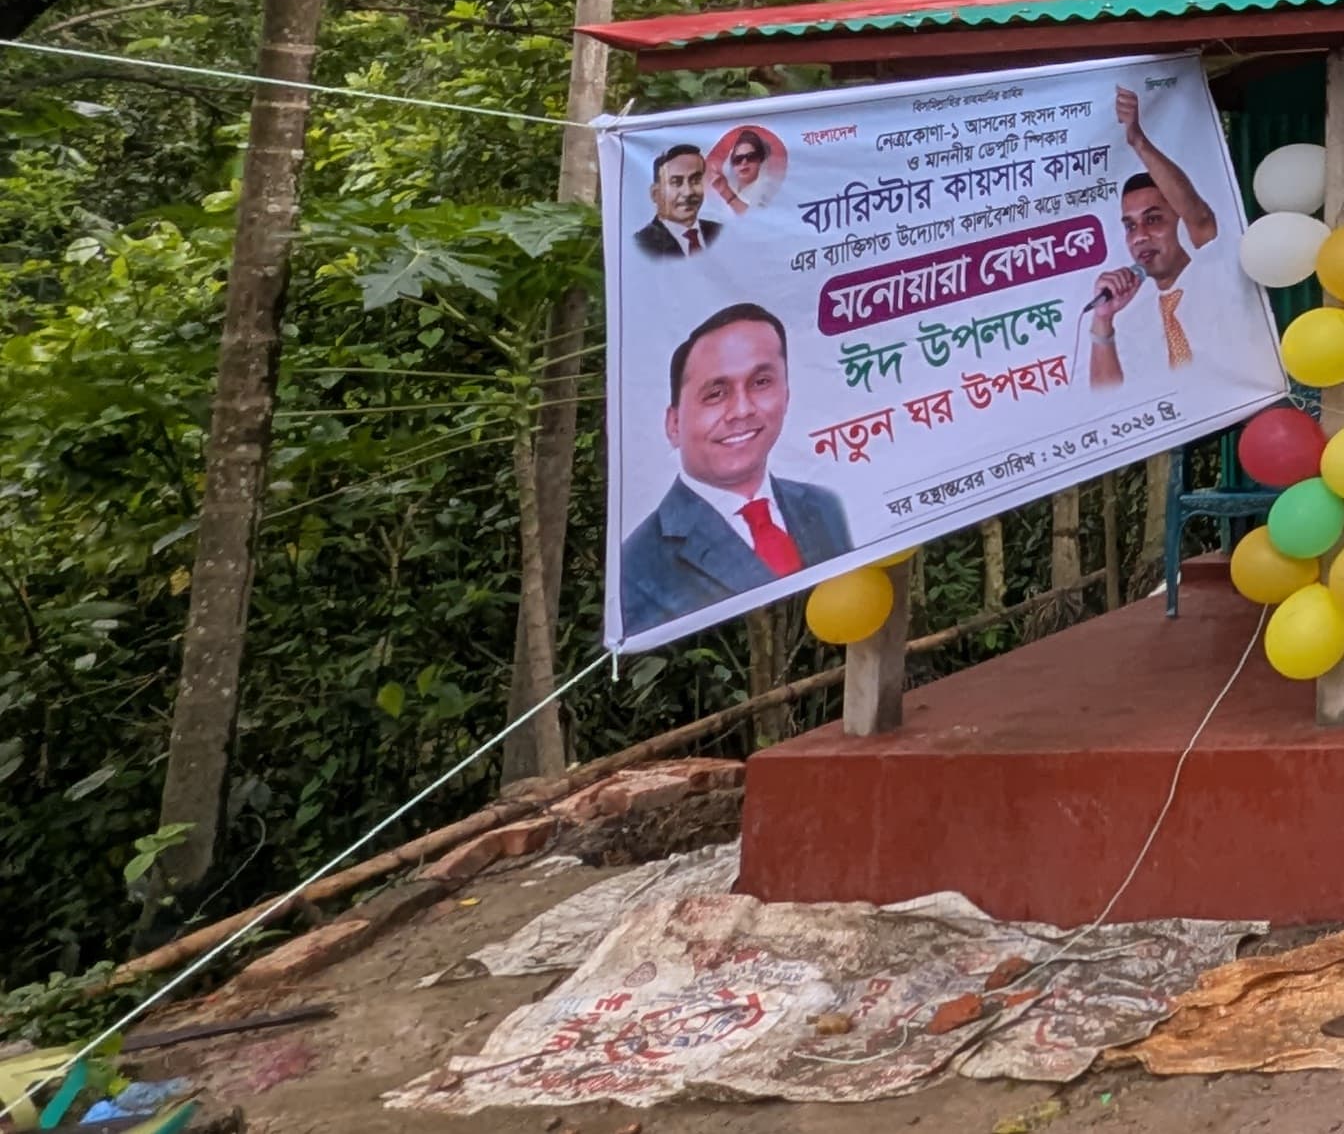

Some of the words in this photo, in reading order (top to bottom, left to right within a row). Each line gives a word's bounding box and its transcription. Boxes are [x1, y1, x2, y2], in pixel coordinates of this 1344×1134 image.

[801, 124, 857, 147] বাংলাদেশ
[876, 122, 960, 152] নেত্রকোণা-১
[964, 112, 1017, 136] আসনের
[1020, 105, 1057, 127] সংসদ
[1059, 99, 1093, 120] সদস্য
[907, 157, 920, 171] ও
[924, 142, 974, 169] মাননীয়
[978, 132, 1020, 161] ডেপুটি
[1022, 127, 1069, 151] স্পিকার
[790, 249, 818, 273] এর
[895, 216, 956, 246] উদ্যোগে
[959, 194, 1031, 233] কালবৈশাখী
[1034, 192, 1063, 216] ঝড়ে
[798, 176, 935, 235] ব্যারিস্টার
[940, 158, 1036, 203] কায়সার
[1042, 144, 1112, 183] কামাল
[827, 253, 972, 324] মনোয়ারা
[979, 226, 1096, 285] বেগম-কে
[838, 341, 908, 394] ঈদ
[916, 298, 1064, 368] উপলক্ষে
[808, 407, 897, 464] নতুন
[902, 389, 954, 431] ঘর
[961, 354, 1070, 410] উপহার
[886, 492, 914, 518] ঘর
[988, 449, 1037, 481] তারিখ
[1050, 439, 1078, 463] ২৬
[1110, 412, 1156, 439] ২০২৬
